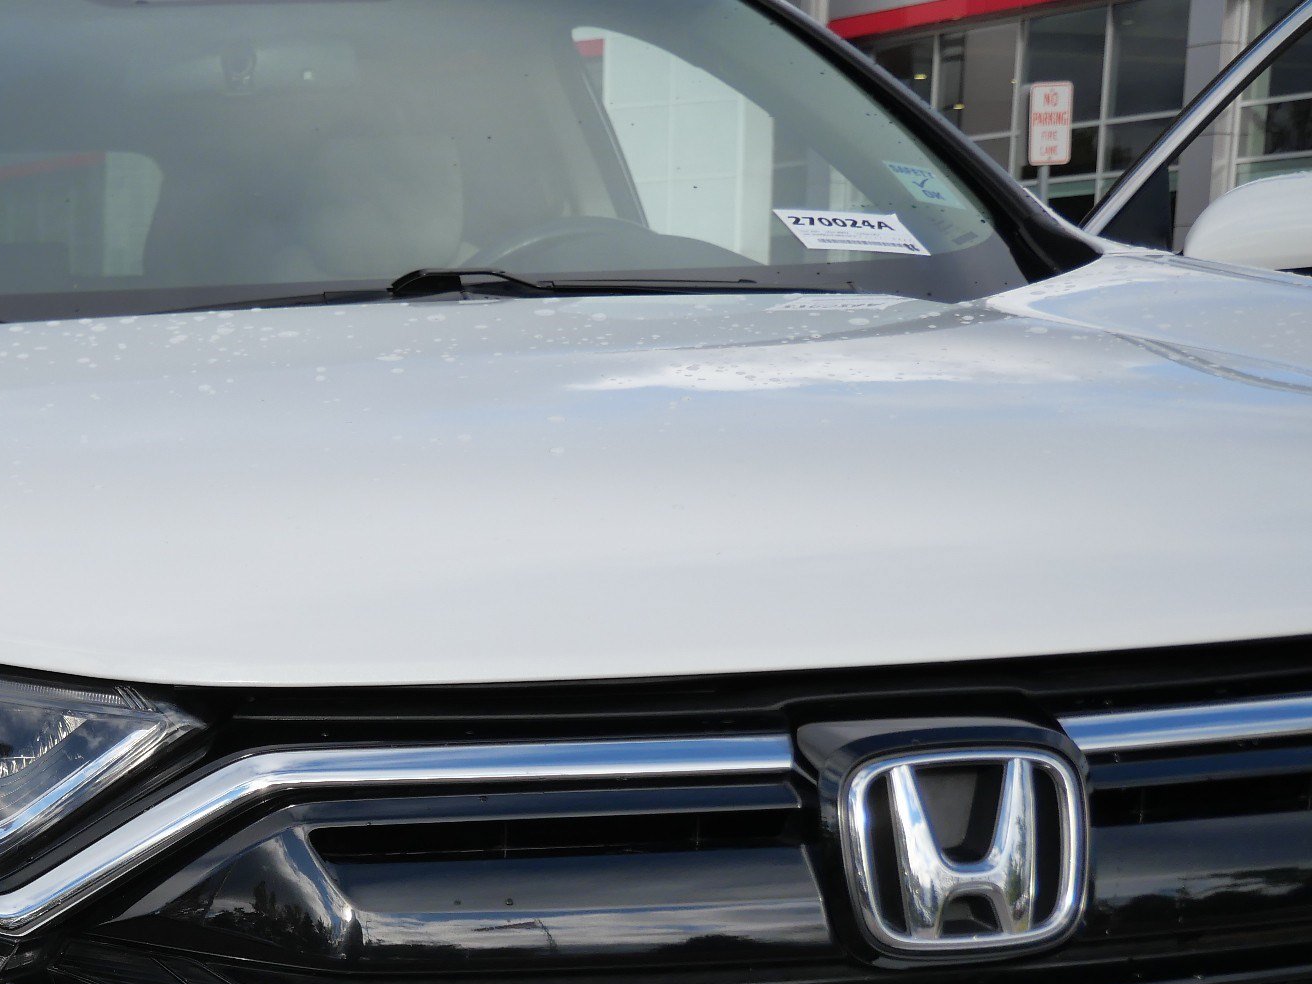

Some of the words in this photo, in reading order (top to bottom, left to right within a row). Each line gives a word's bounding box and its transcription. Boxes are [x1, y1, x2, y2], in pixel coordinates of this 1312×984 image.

[1043, 92, 1059, 107] NO
[1032, 111, 1069, 127] PARKING
[888, 164, 935, 179] SAFETY
[787, 215, 895, 231] 270024A
